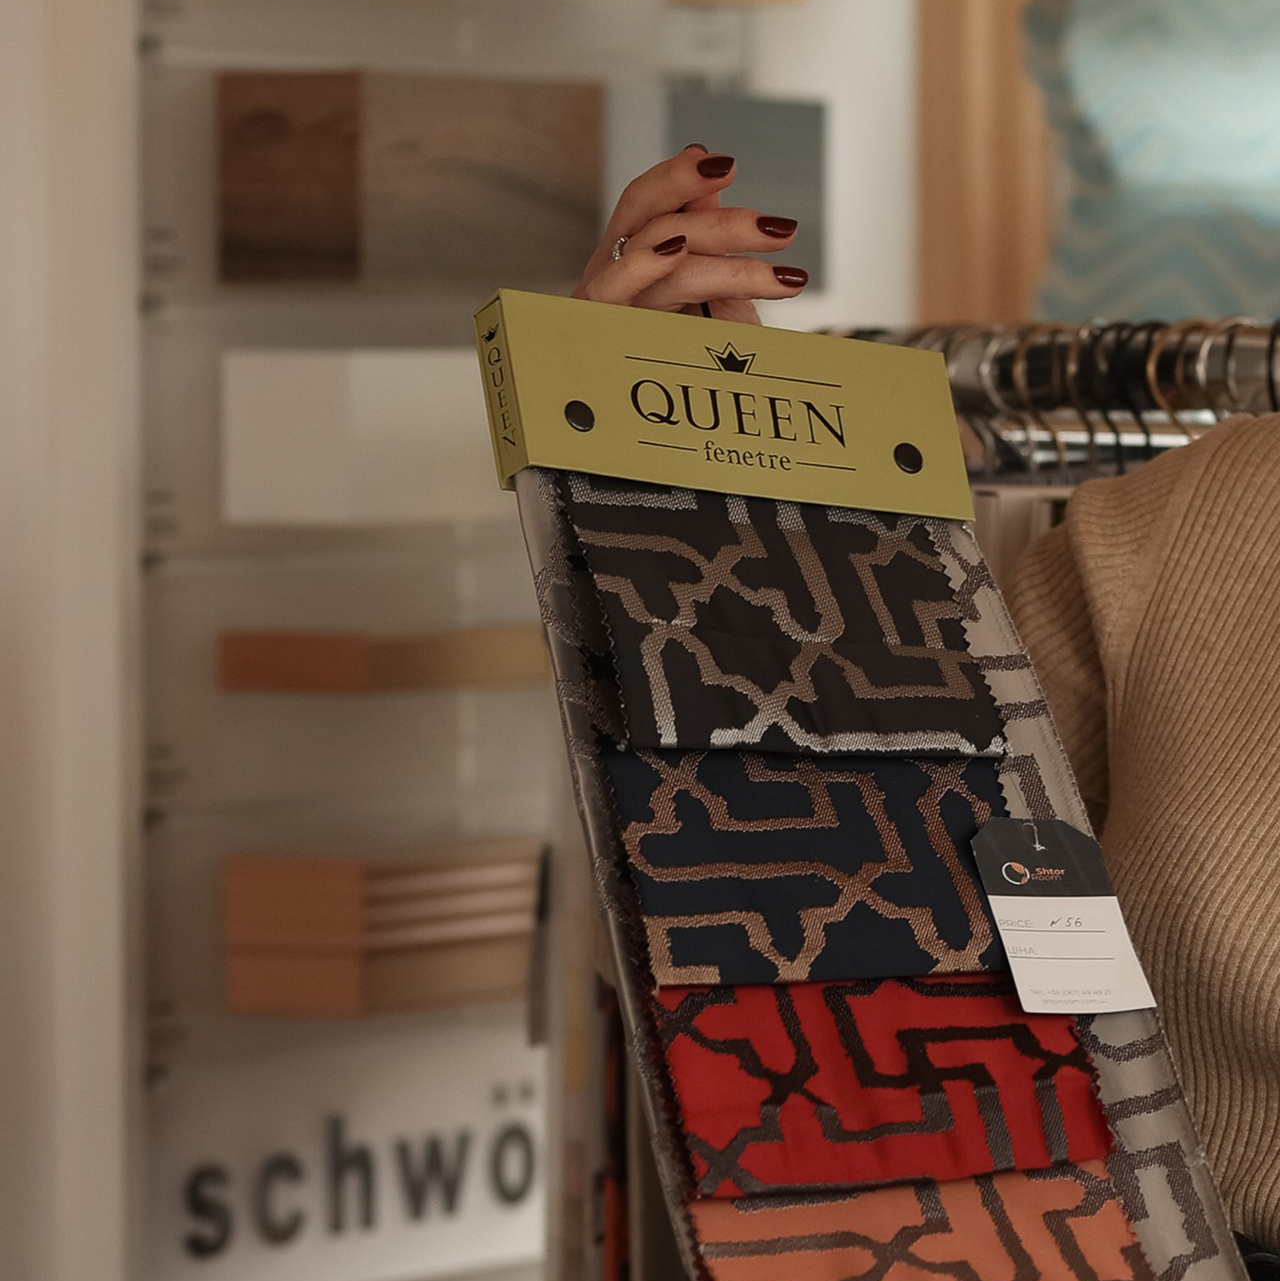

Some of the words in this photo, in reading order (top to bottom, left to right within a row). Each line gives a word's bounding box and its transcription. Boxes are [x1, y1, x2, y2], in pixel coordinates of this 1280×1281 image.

[487, 346, 516, 448] QUEEN
[629, 378, 847, 449] QUEEN
[702, 439, 793, 472] fenetre
[1034, 867, 1066, 876] Shtor
[180, 1081, 537, 1262] schwö
